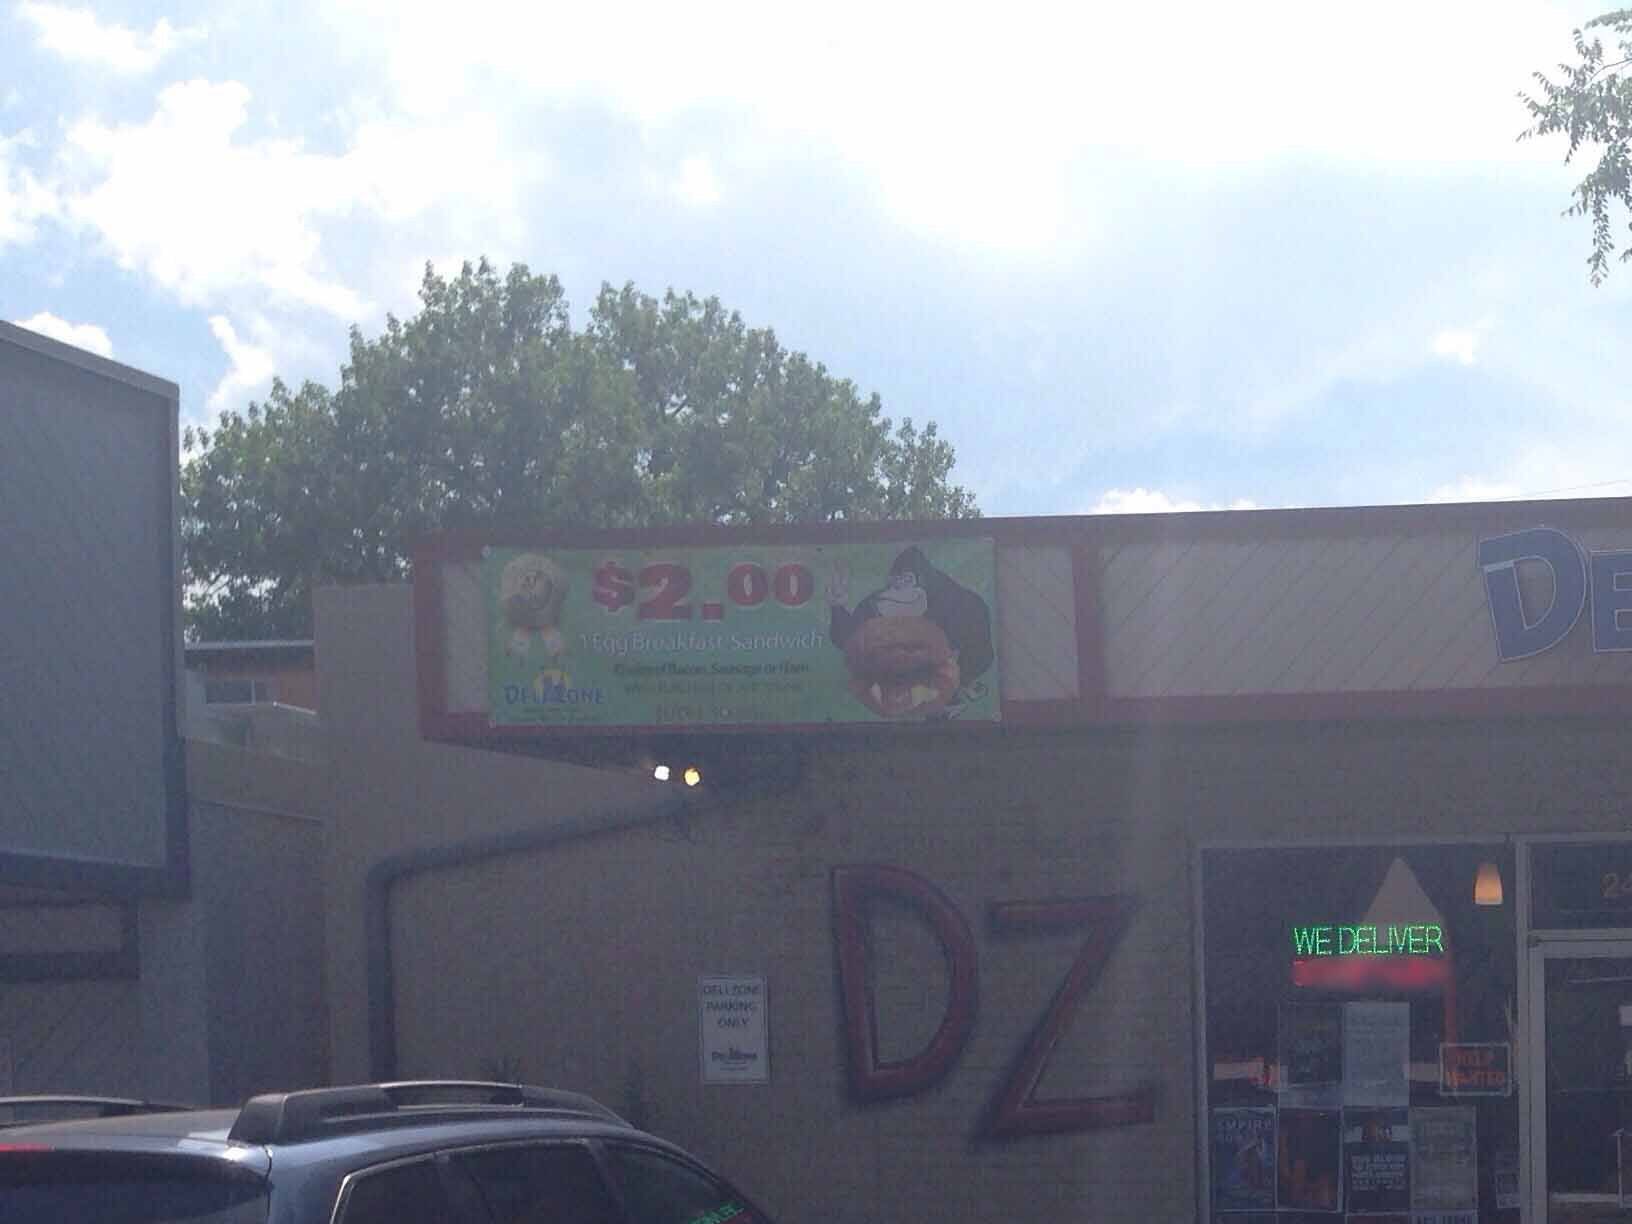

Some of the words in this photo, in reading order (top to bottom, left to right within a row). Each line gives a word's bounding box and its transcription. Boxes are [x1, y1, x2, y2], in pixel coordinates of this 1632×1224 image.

[591, 560, 816, 622] $2.00
[591, 633, 629, 656] Egg
[631, 631, 723, 651] Breakfast
[730, 630, 826, 651] Sandwich
[1293, 926, 1333, 956] WE
[1337, 922, 1448, 956] DELIVER
